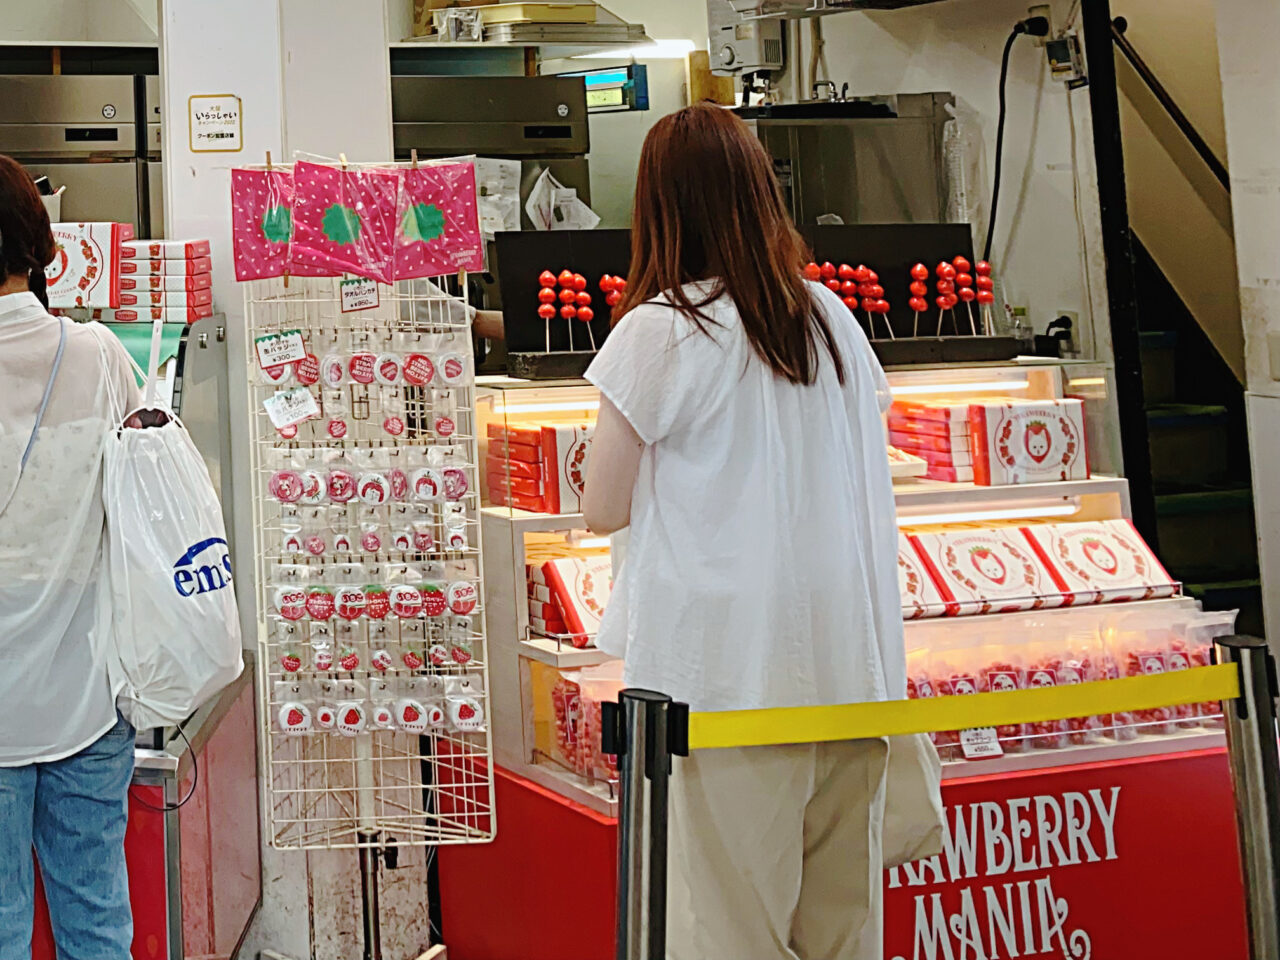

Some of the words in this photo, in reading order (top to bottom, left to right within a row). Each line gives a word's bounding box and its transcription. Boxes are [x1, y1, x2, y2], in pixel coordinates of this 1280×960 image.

[195, 112, 237, 121] いらっしゃい
[890, 874, 1091, 960] MANIA
